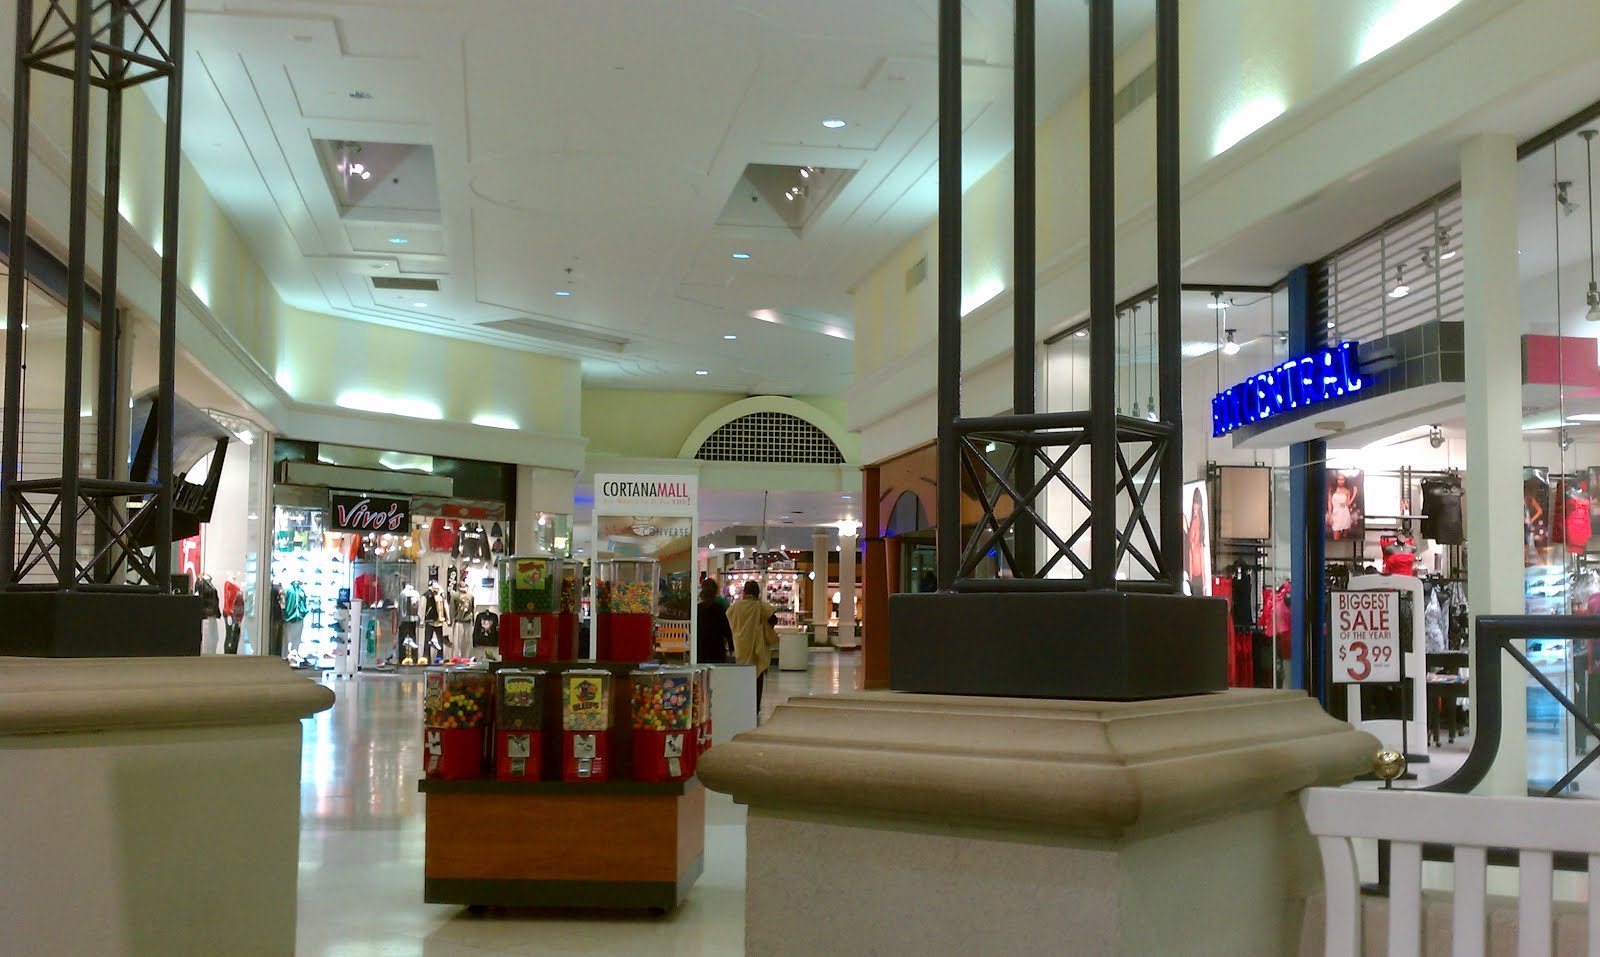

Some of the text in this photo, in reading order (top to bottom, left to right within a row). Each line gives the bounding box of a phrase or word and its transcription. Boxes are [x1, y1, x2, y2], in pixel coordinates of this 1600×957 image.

[337, 499, 405, 531] Vivo's
[642, 528, 689, 537] CONVERSE
[1339, 594, 1390, 610] BIGGEST
[1340, 610, 1390, 631] SALE
[1340, 632, 1350, 640] OF
[1353, 632, 1366, 640] THE
